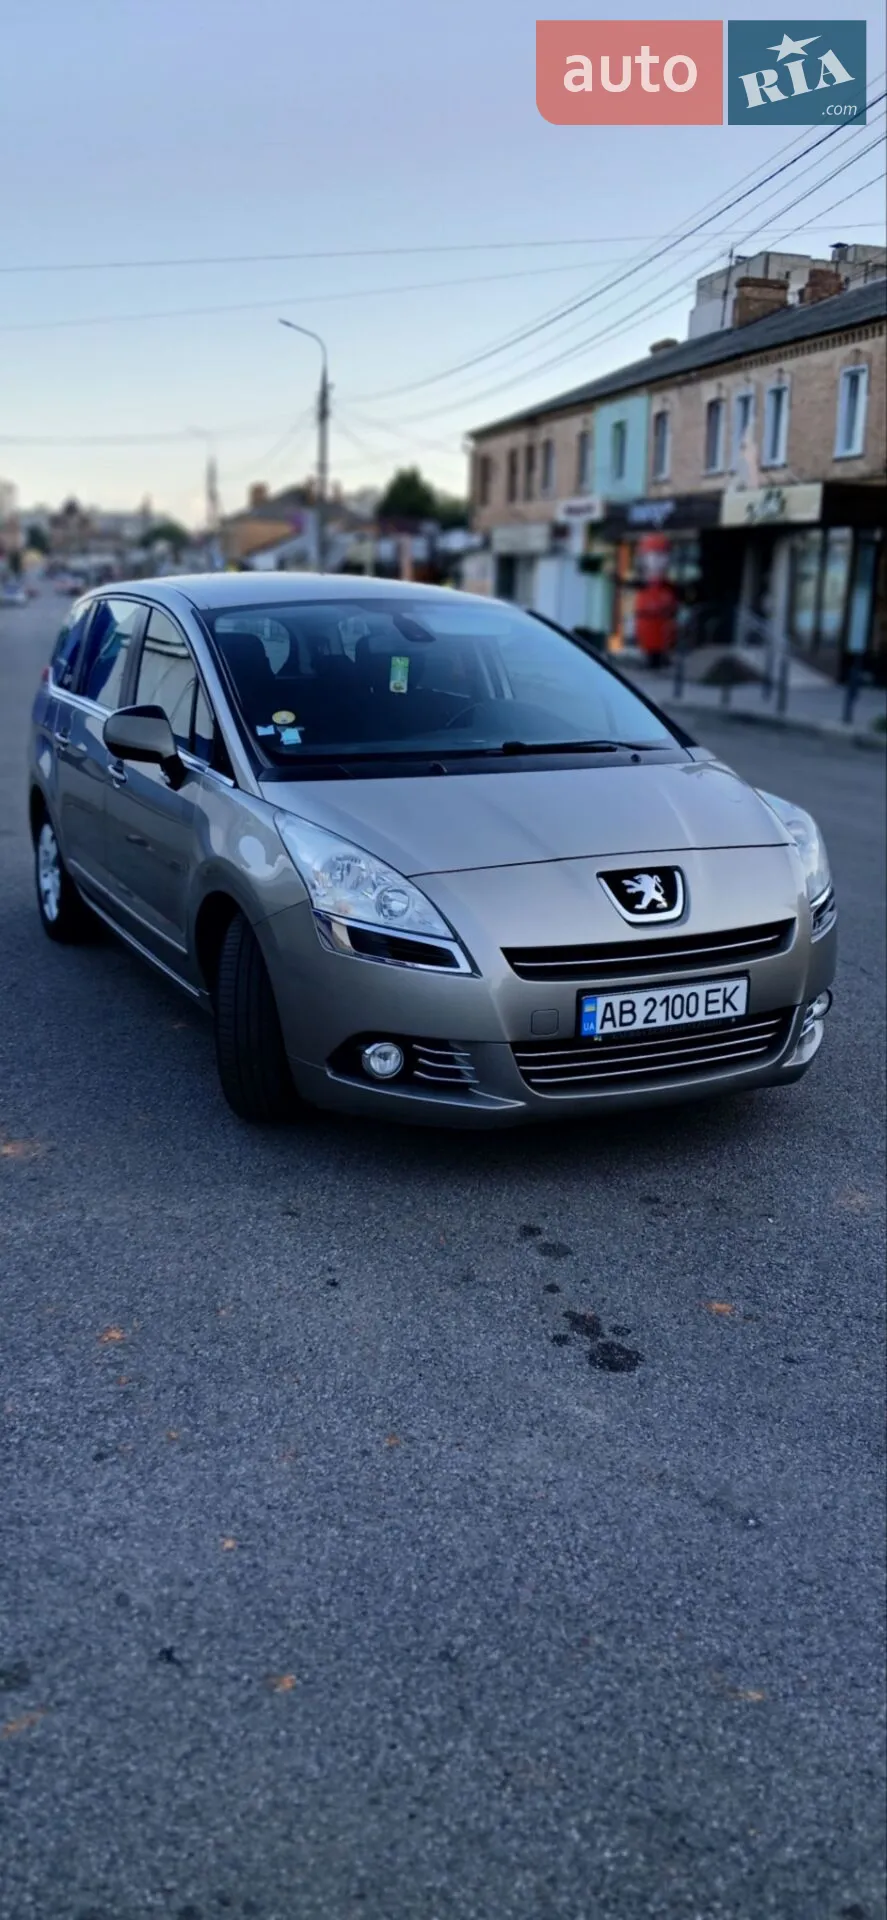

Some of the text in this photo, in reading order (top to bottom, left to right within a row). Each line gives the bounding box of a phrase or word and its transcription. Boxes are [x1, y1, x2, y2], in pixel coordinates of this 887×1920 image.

[600, 1000, 637, 1030] AB
[643, 992, 699, 1024] 2100
[705, 986, 740, 1016] EK
[583, 1021, 595, 1031] UA
